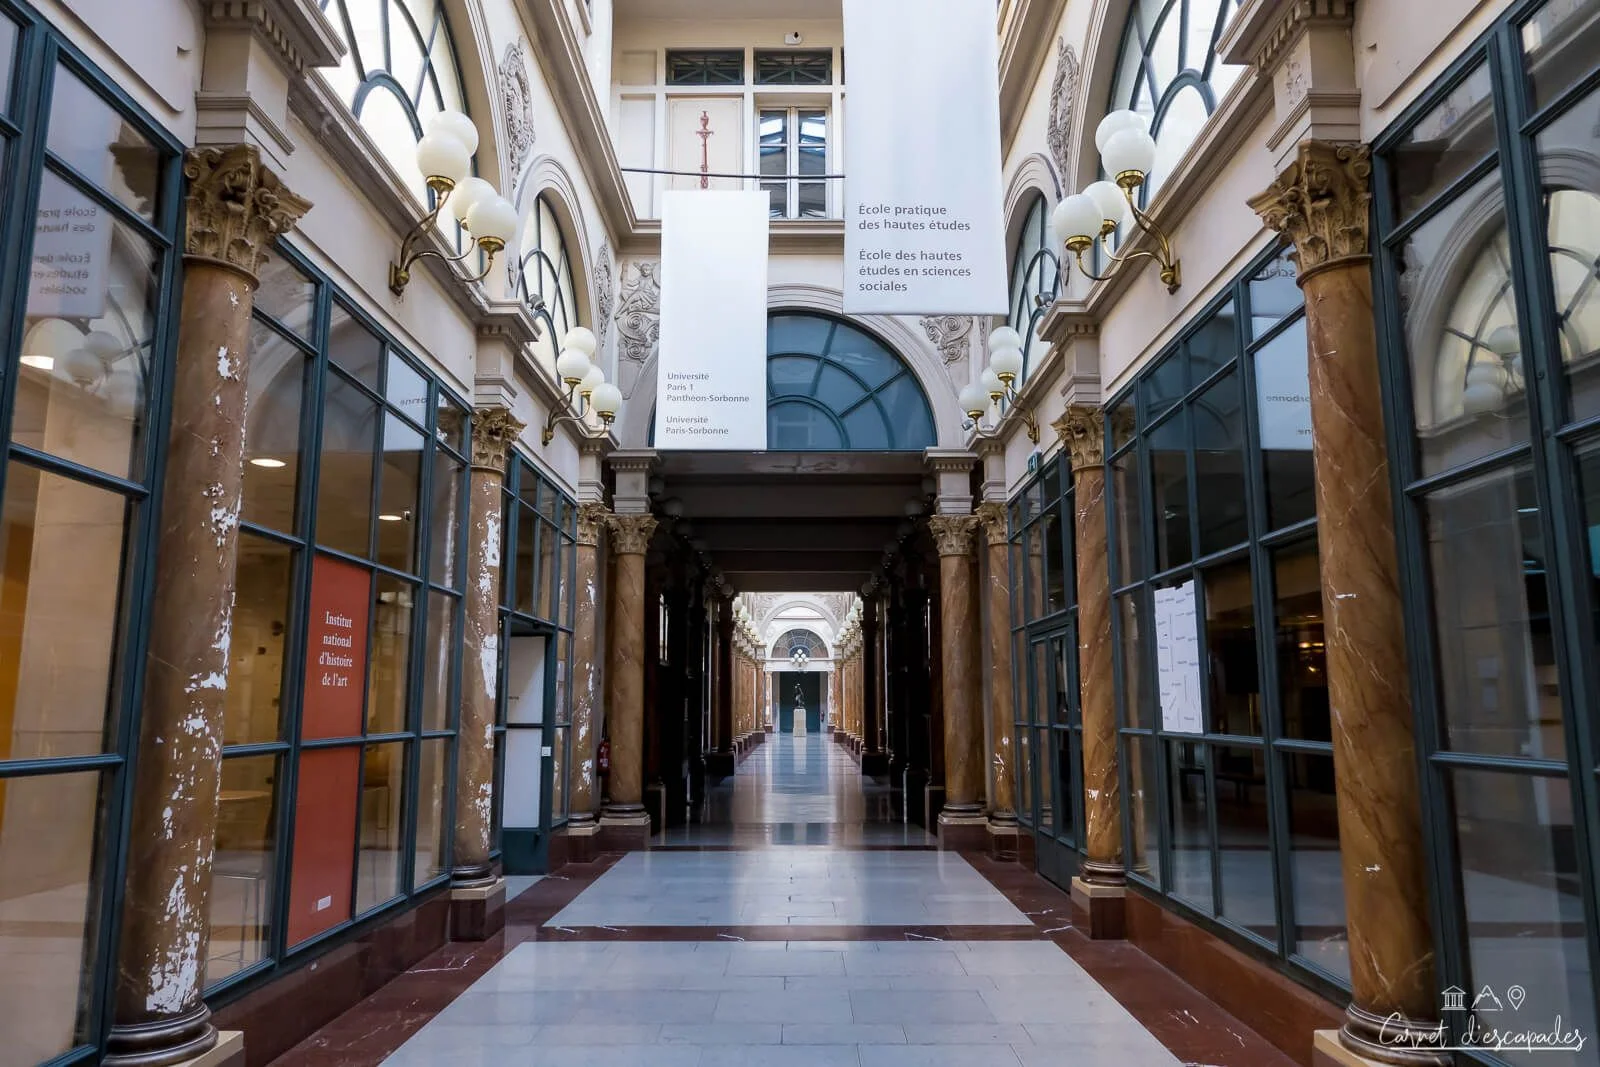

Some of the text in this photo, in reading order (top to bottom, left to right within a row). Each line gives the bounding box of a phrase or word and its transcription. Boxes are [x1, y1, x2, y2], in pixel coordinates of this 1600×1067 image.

[858, 202, 947, 217] École pratique
[858, 218, 971, 231] des hautes études
[859, 248, 962, 261] École des hautes
[859, 264, 971, 277] études en sciences
[859, 280, 908, 292] sociales
[667, 372, 710, 380] Université
[667, 383, 687, 391] Paris
[666, 394, 750, 402] Panthéon-Sorbonne
[666, 415, 709, 424] Université
[665, 426, 729, 435] Paris-Sorbonne
[325, 610, 352, 628] Institut
[322, 632, 352, 648] national
[319, 651, 353, 668] d'histoire
[322, 672, 348, 687] de l'art
